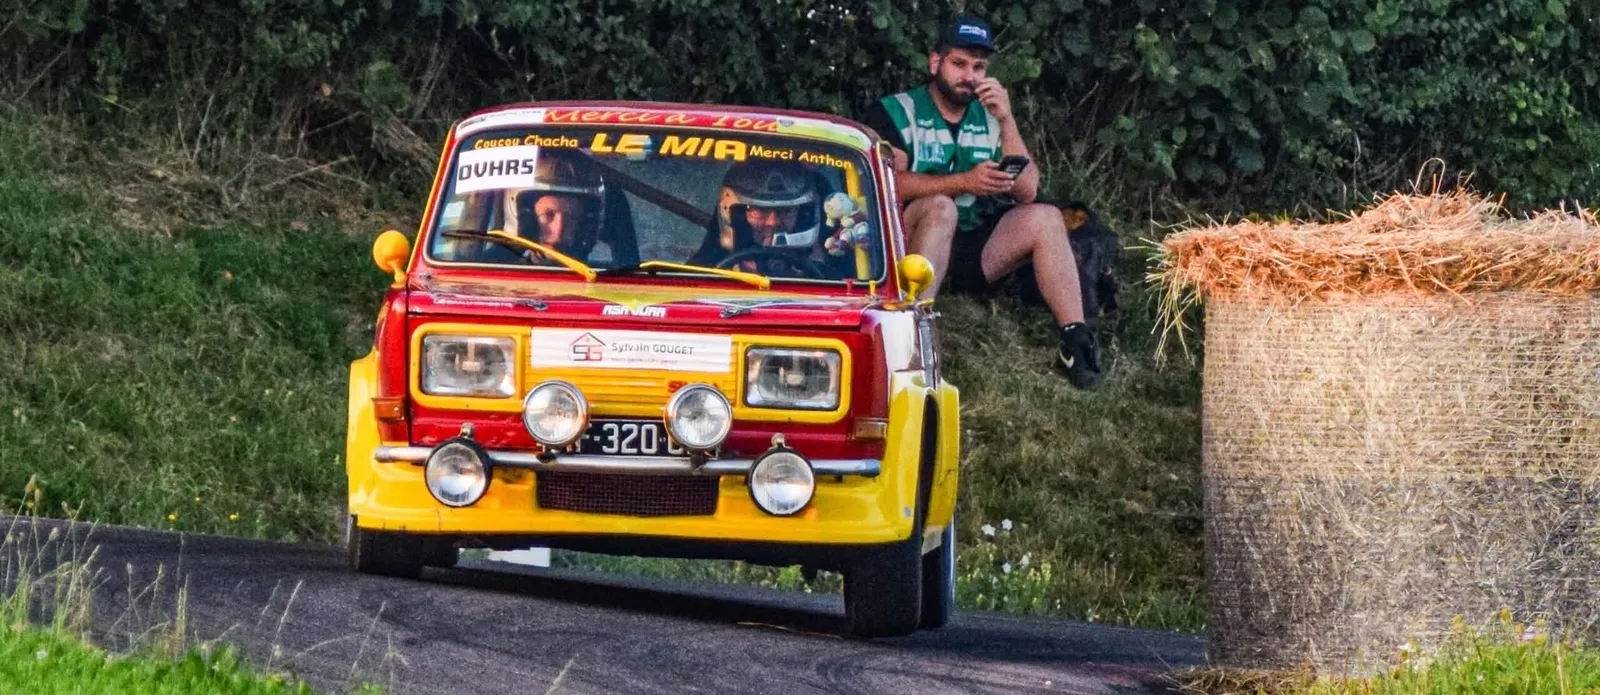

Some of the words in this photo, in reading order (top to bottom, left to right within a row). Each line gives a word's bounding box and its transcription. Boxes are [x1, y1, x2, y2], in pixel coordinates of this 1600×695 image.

[474, 138, 520, 150] Coucou
[523, 134, 579, 148] Chacha
[590, 133, 652, 154] LE
[659, 135, 747, 162] MIA
[749, 145, 794, 160] Merci
[603, 305, 630, 317] ASA
[611, 342, 650, 355] Sylvain
[652, 343, 695, 356] GOUGET
